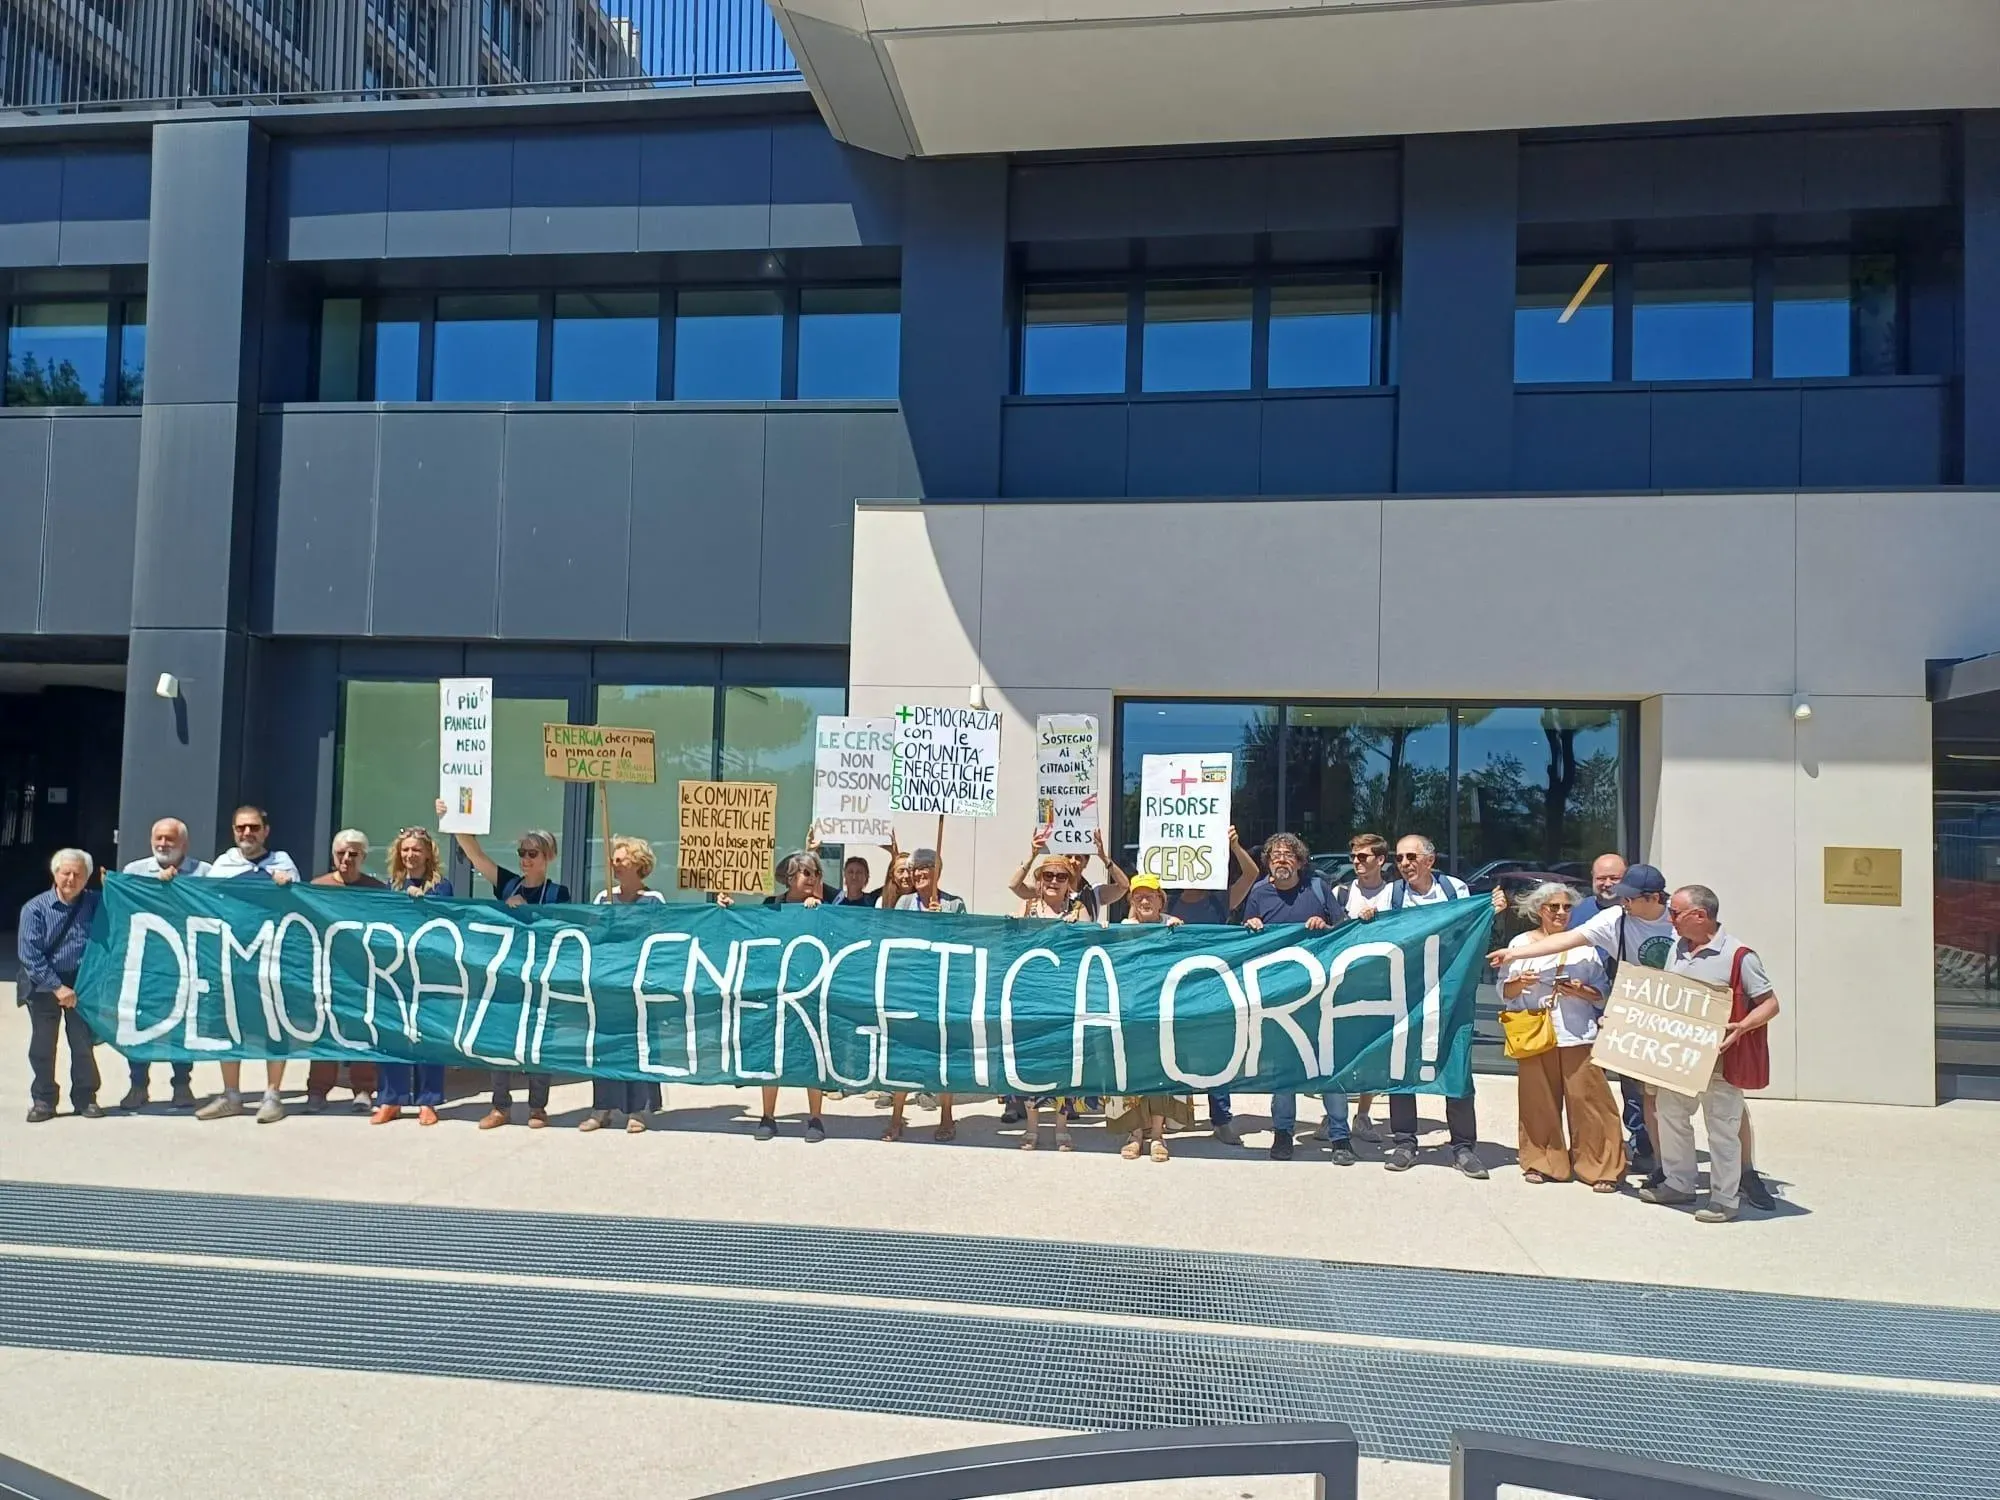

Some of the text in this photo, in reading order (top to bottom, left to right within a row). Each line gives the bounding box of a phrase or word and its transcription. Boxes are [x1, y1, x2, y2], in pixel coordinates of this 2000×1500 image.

[456, 739, 486, 752] MENO
[818, 731, 893, 751] LE CERS
[904, 727, 968, 745] con le
[1042, 733, 1093, 745] SOSTEGNO
[546, 745, 632, 758] la rima con la
[840, 752, 874, 769] NON
[567, 758, 611, 778] PACE
[893, 759, 994, 782] ENERGETICHE
[815, 769, 891, 791] POSSONO
[681, 785, 692, 804] le
[890, 795, 954, 814] SOLIDALI
[1146, 796, 1220, 817] RISORSE
[681, 807, 771, 831] ENERGETICHE
[813, 817, 892, 836] ASPETTARE
[1063, 819, 1074, 827] LA
[1054, 830, 1092, 843] CERS
[1161, 822, 1205, 839] PER LE
[680, 834, 711, 847] sono
[714, 831, 724, 847] la
[726, 831, 749, 848] base
[750, 836, 765, 852] per
[680, 848, 769, 870] TRANSIZIONE
[1143, 845, 1212, 882] CERS
[680, 868, 763, 891] ENERGETICA
[115, 910, 1440, 1092] DEMOCRAZIA ENERGETICA ORA!
